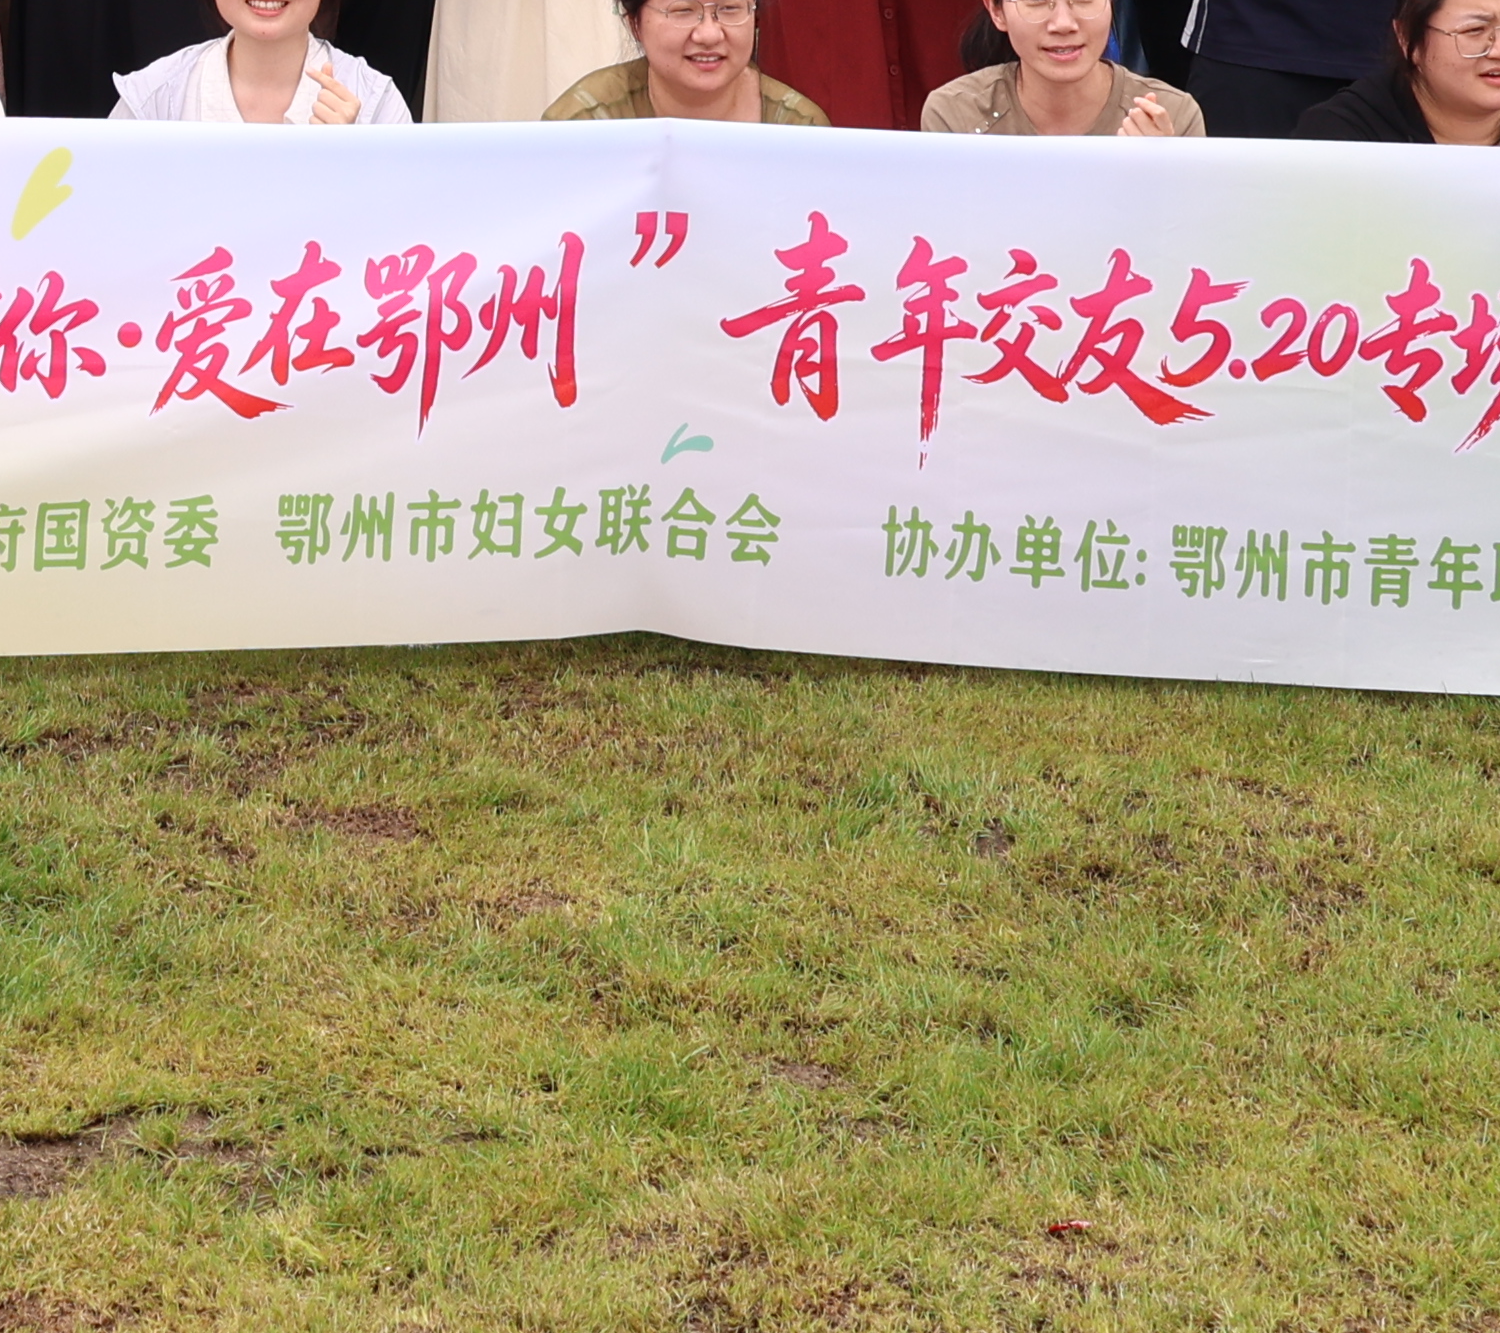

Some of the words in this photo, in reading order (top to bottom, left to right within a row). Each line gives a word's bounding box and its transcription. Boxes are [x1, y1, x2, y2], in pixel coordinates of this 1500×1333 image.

[274, 482, 783, 569] 鄂州市妇女联合会
